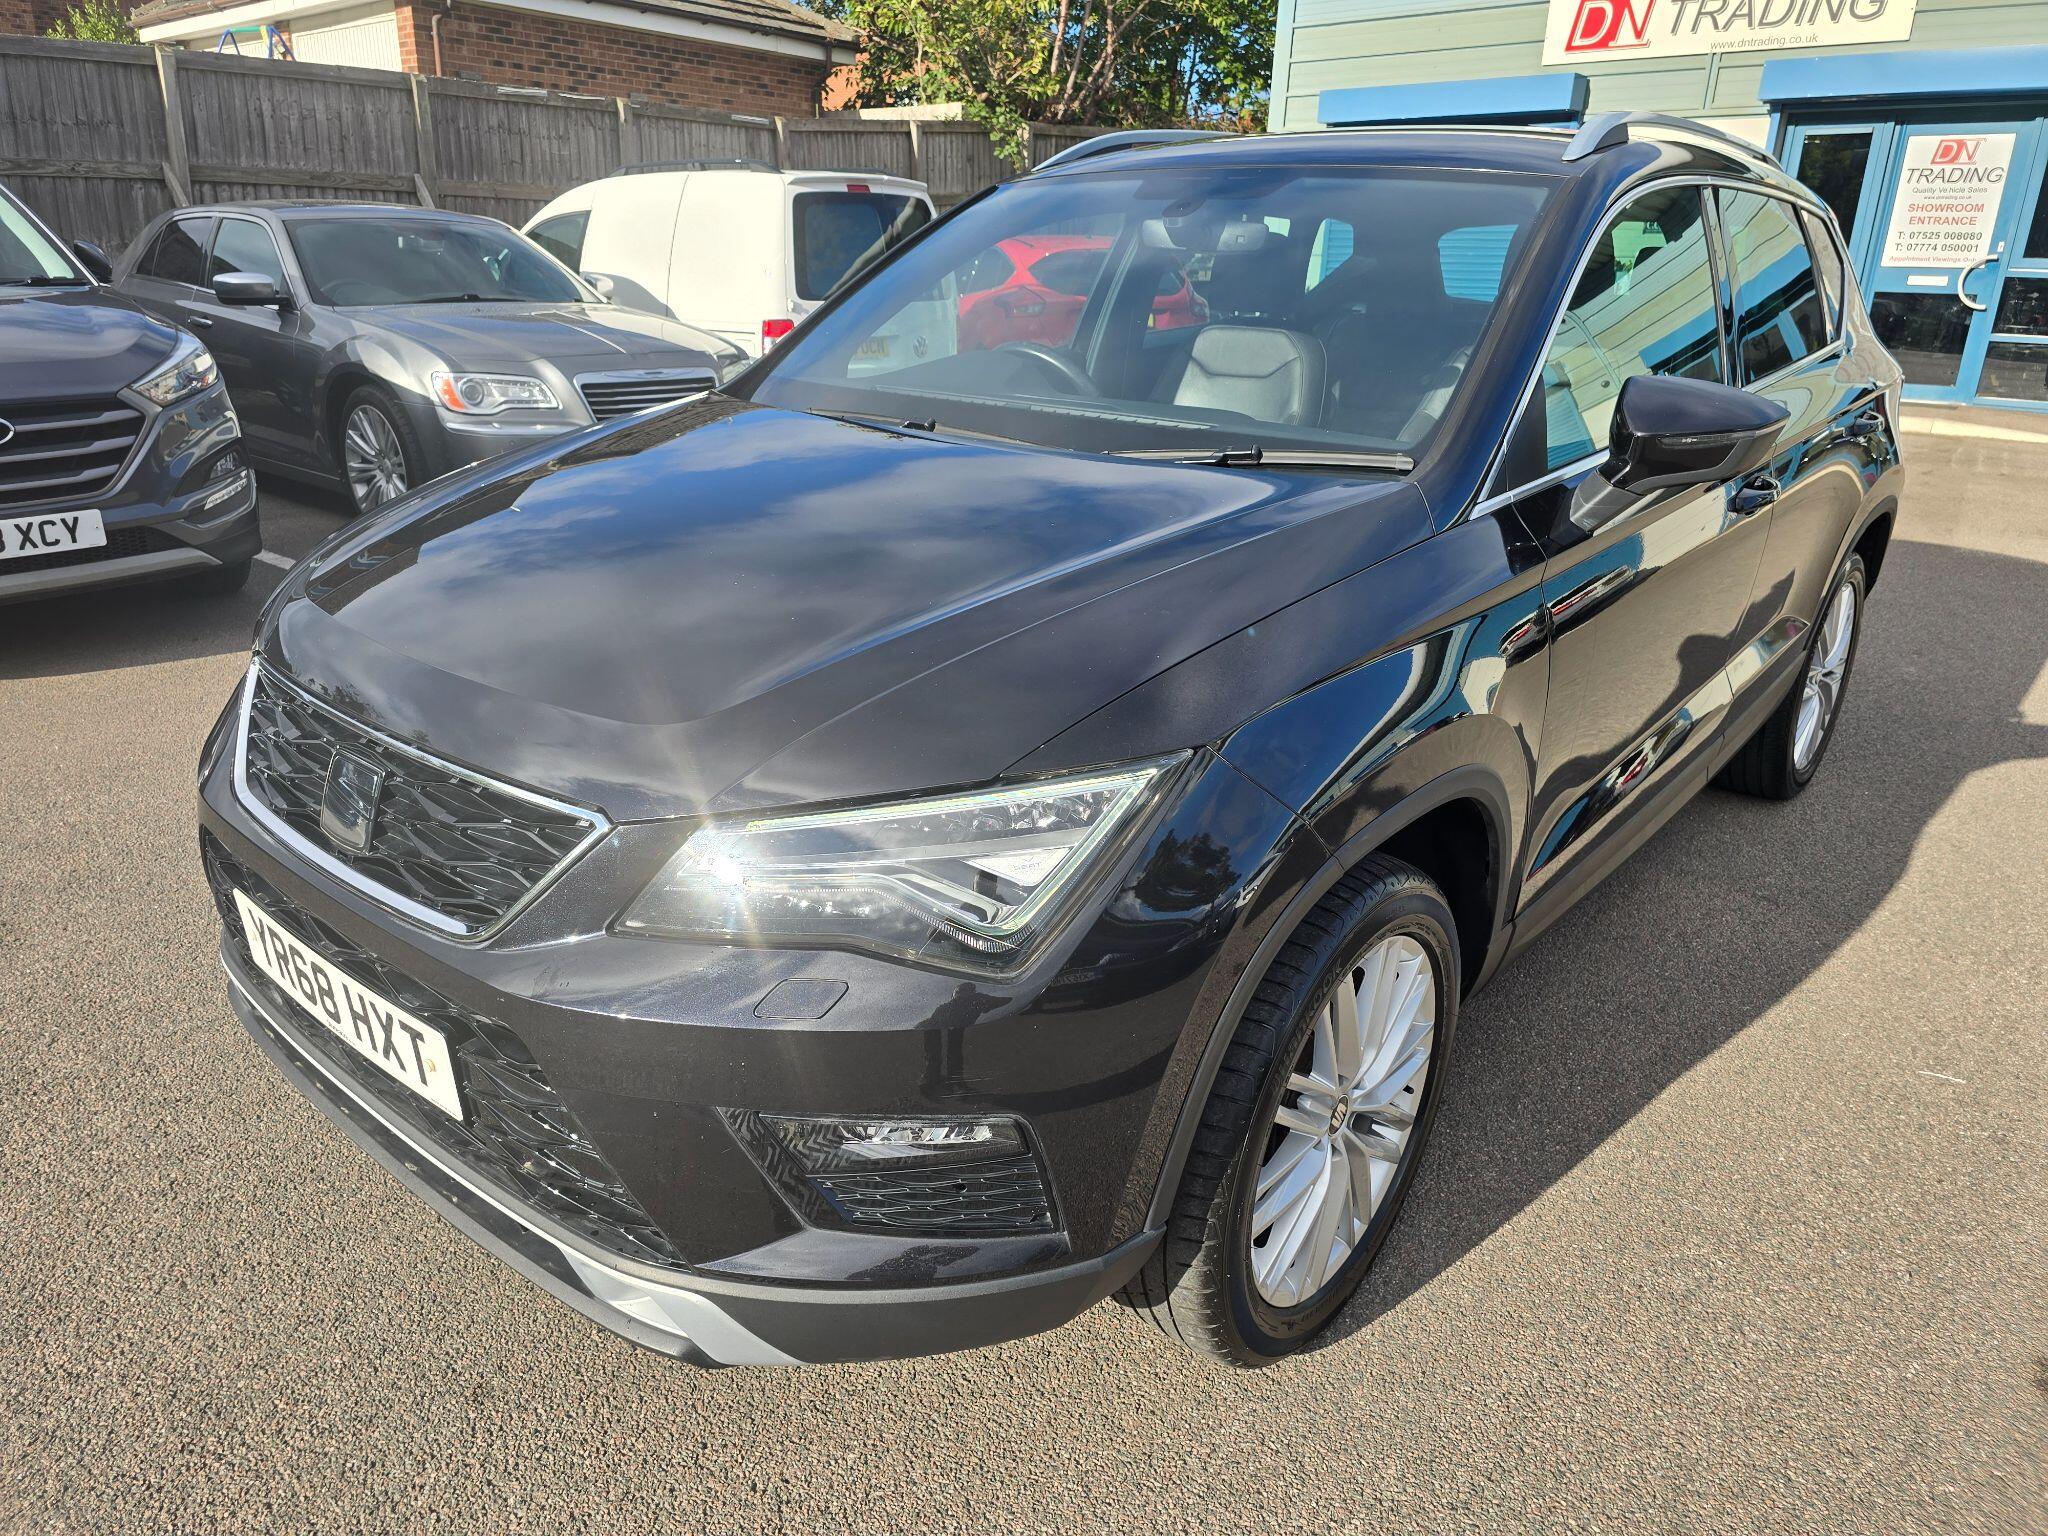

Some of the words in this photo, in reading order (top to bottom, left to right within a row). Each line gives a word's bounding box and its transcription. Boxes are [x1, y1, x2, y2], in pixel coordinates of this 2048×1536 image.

[1567, 0, 1657, 52] DN
[1669, 0, 1888, 36] TRADING
[1710, 33, 1818, 50] www.dntrading.co.uk
[1930, 138, 1986, 166] DN
[1906, 167, 2004, 184] TRADING
[1912, 187, 1936, 195] Quality
[1967, 186, 1988, 194] Sales
[1907, 203, 1985, 213] SHOWROOM
[1908, 216, 1978, 226] ENTRANCE
[1897, 231, 1905, 240] T:
[1909, 231, 1940, 240] 07525
[1943, 231, 1983, 241] 008080
[1895, 243, 1902, 251] T:
[1906, 243, 1937, 252] 07774
[1940, 243, 1979, 252] 050001
[13, 516, 79, 551] XCY
[247, 907, 342, 1025] YR68
[342, 982, 428, 1087] HXT
